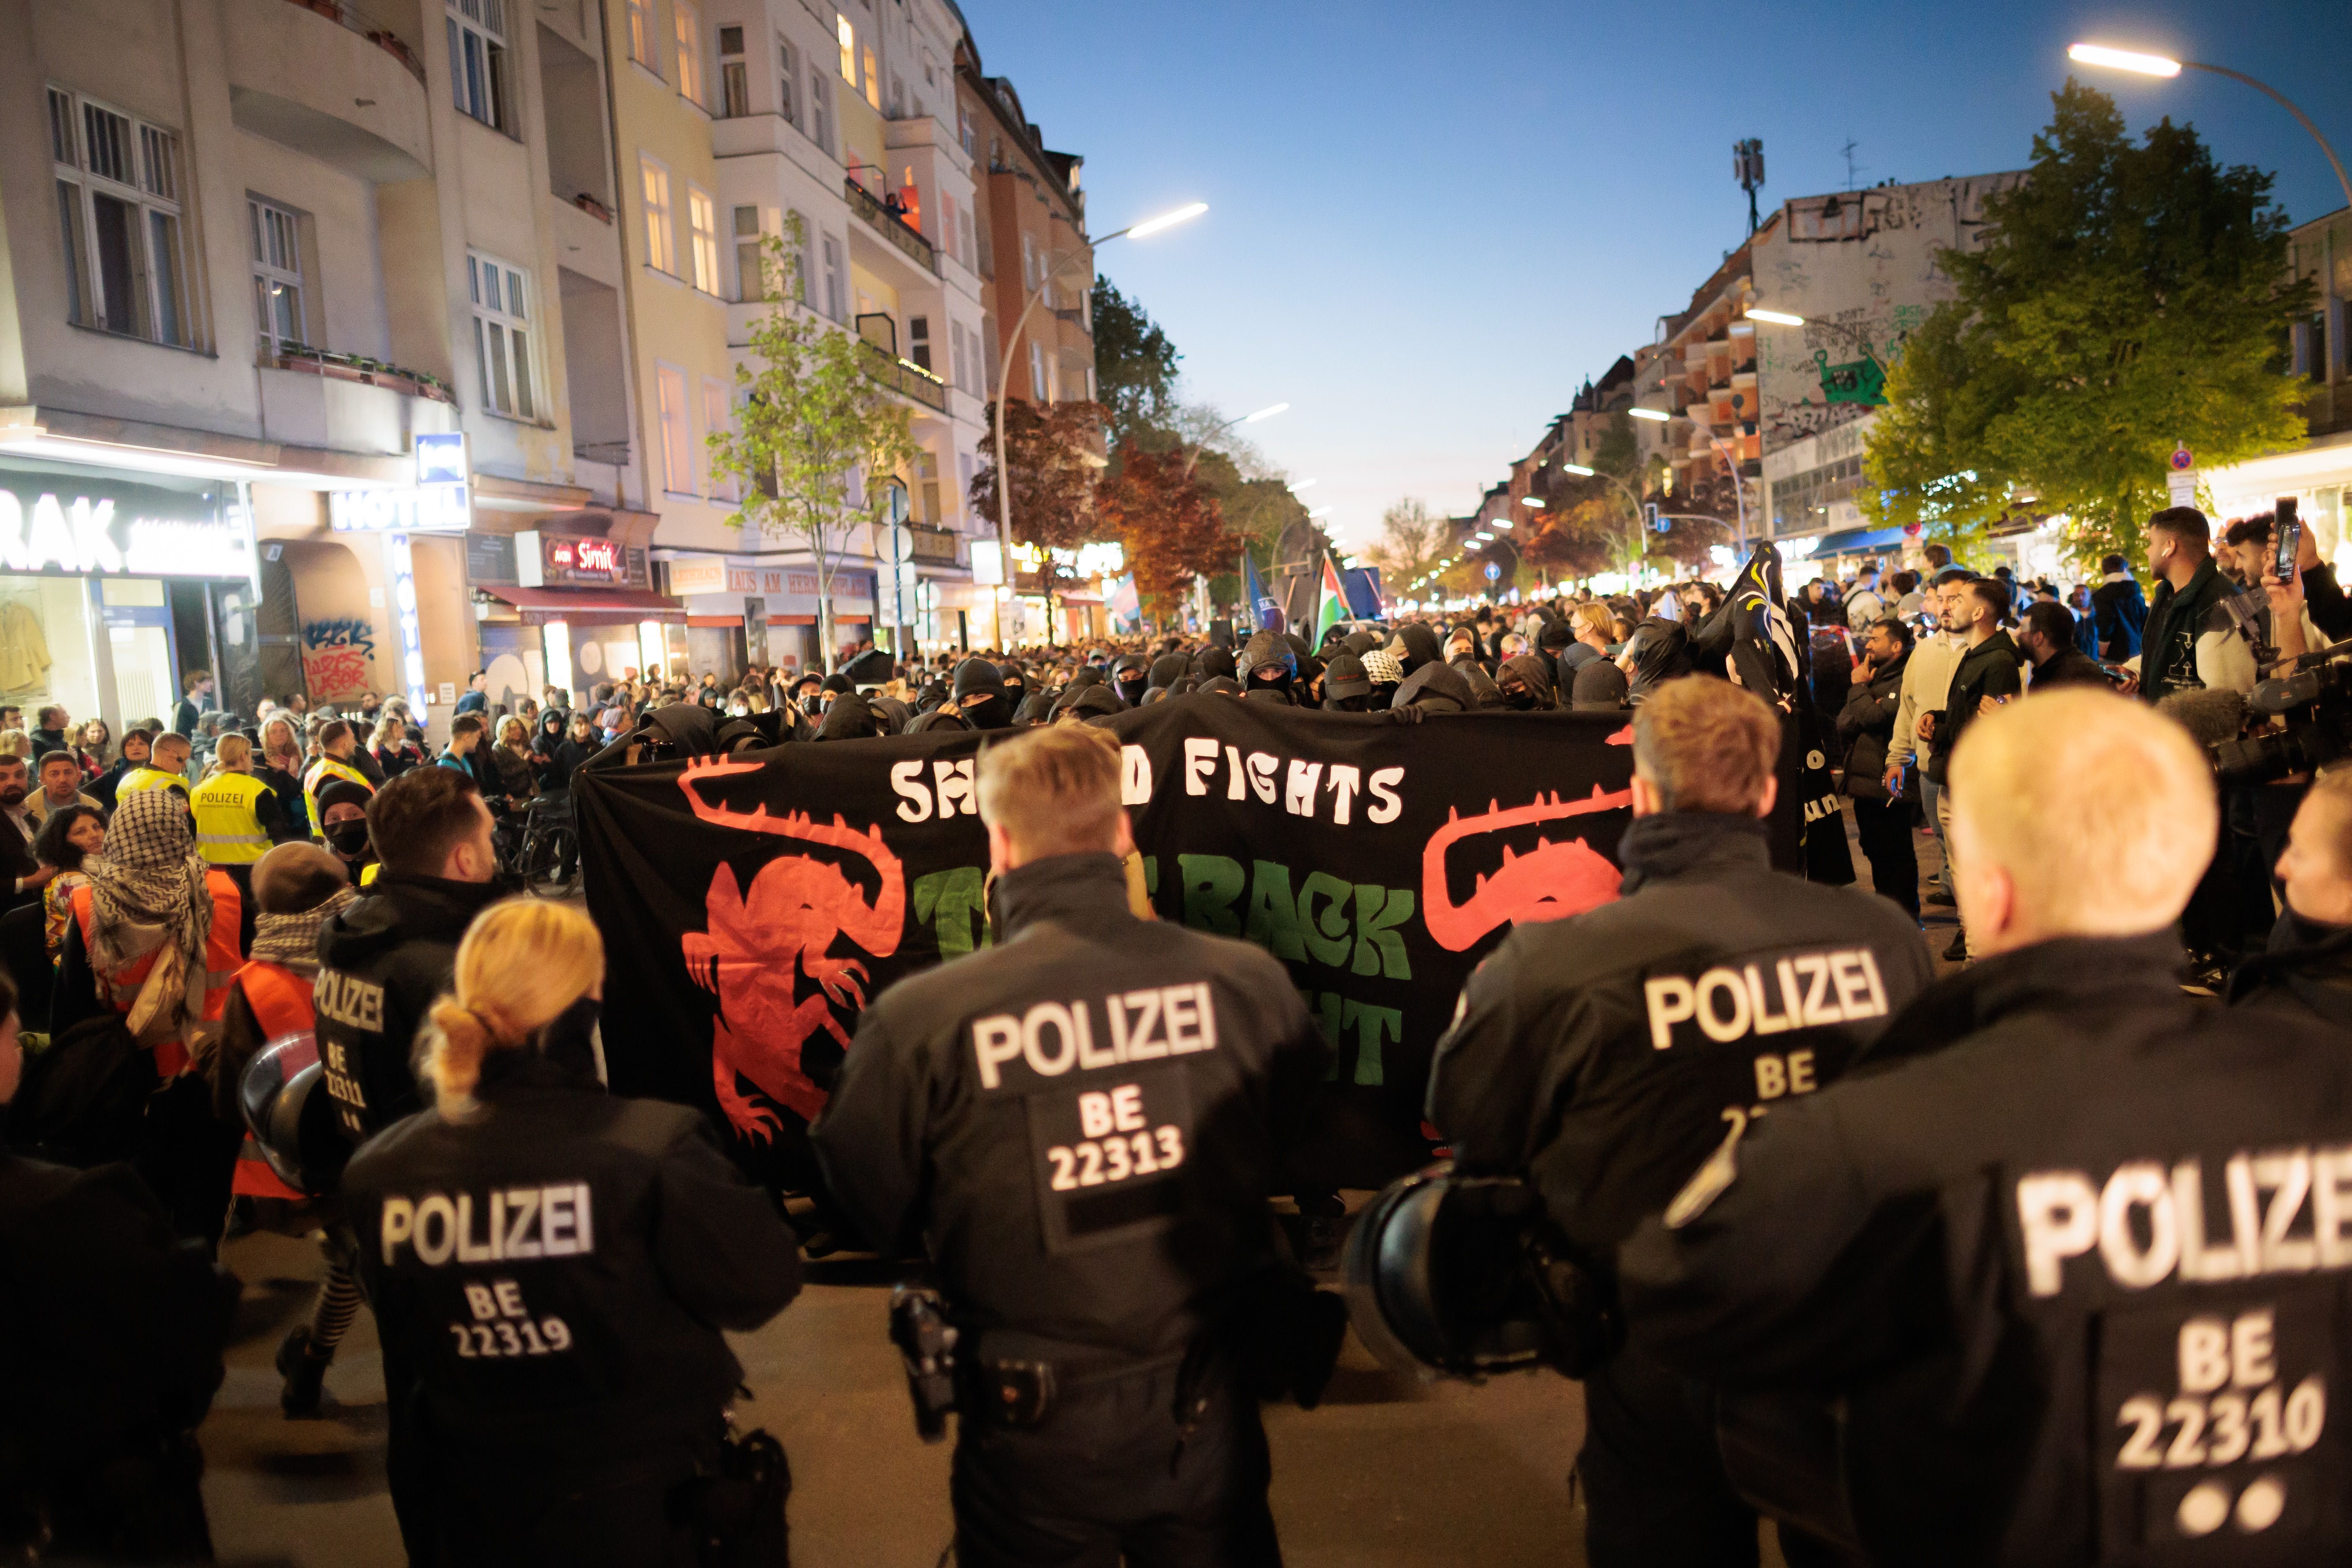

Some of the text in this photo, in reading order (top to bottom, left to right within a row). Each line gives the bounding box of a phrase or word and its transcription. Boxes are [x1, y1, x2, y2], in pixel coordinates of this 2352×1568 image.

[578, 542, 613, 570] Simit
[764, 572, 781, 594] AM
[200, 792, 244, 804] POLIZEI
[1185, 738, 1405, 825] FIGHTS
[313, 968, 383, 1032] POLIZEI
[1644, 948, 1889, 1050] POLIZEI
[972, 982, 1217, 1089] POLIZEI
[1754, 1050, 1815, 1099] BE
[1078, 1084, 1146, 1138] BE
[1047, 1123, 1184, 1192] 22313
[381, 1182, 593, 1265] POLIZEI
[465, 1280, 526, 1320] BE
[450, 1317, 572, 1357] 22319
[2178, 1308, 2275, 1393] BE
[2116, 1374, 2326, 1468] 22310
